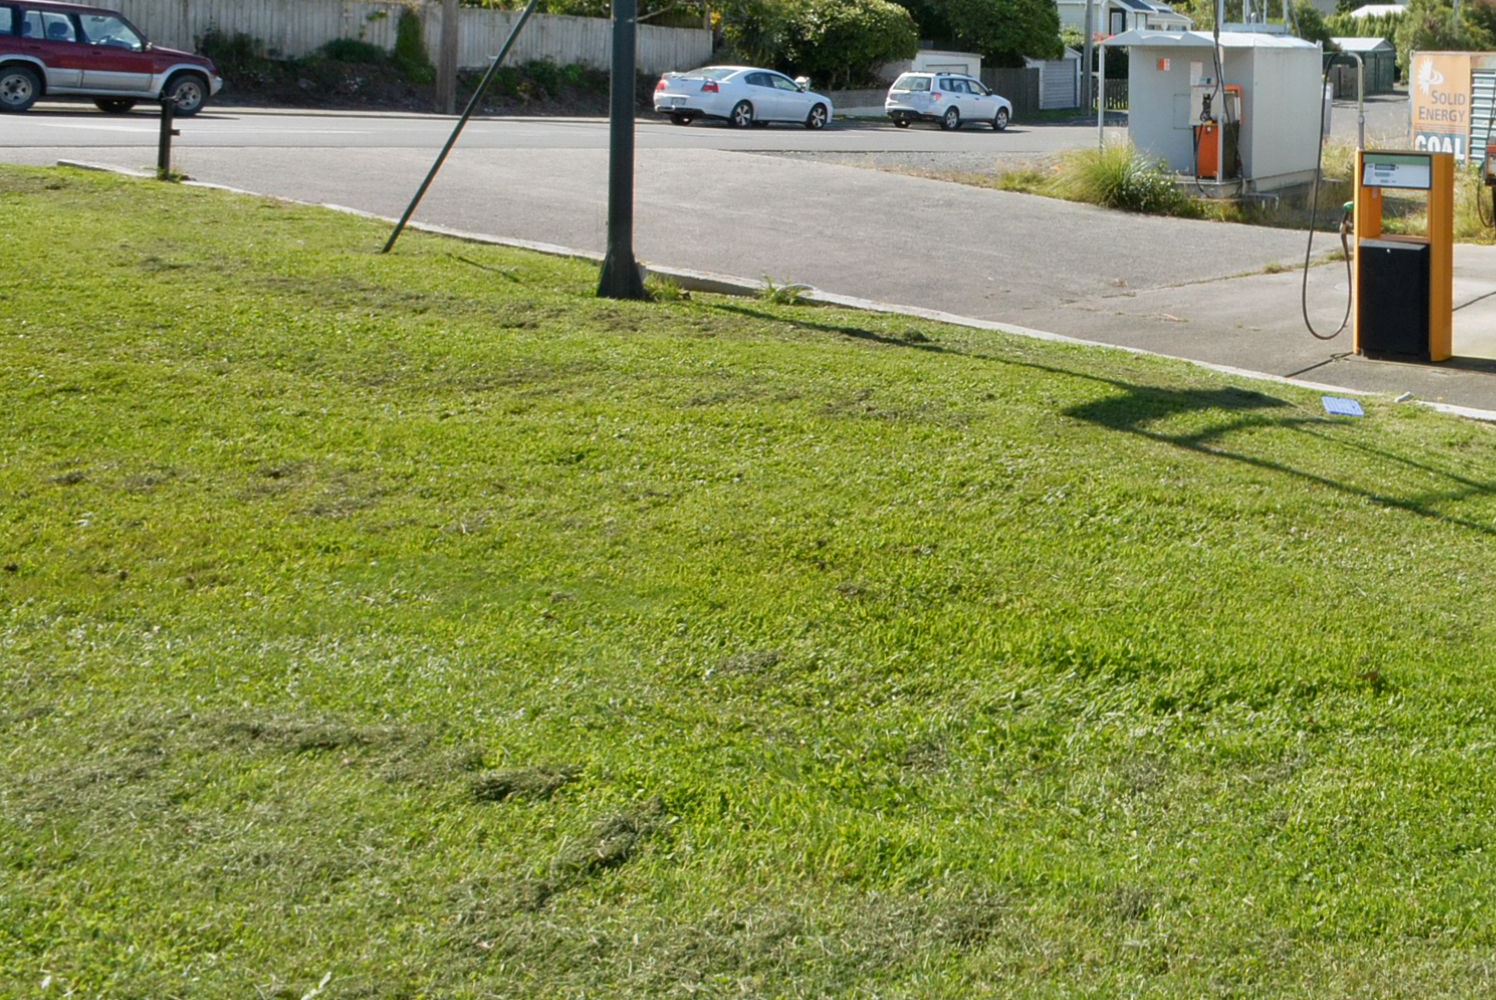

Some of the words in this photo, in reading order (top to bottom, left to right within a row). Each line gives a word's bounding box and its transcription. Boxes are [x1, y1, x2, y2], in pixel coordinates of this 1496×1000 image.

[1431, 90, 1466, 106] SOLID
[1418, 106, 1466, 122] ENERGY
[1415, 134, 1466, 160] COAL
